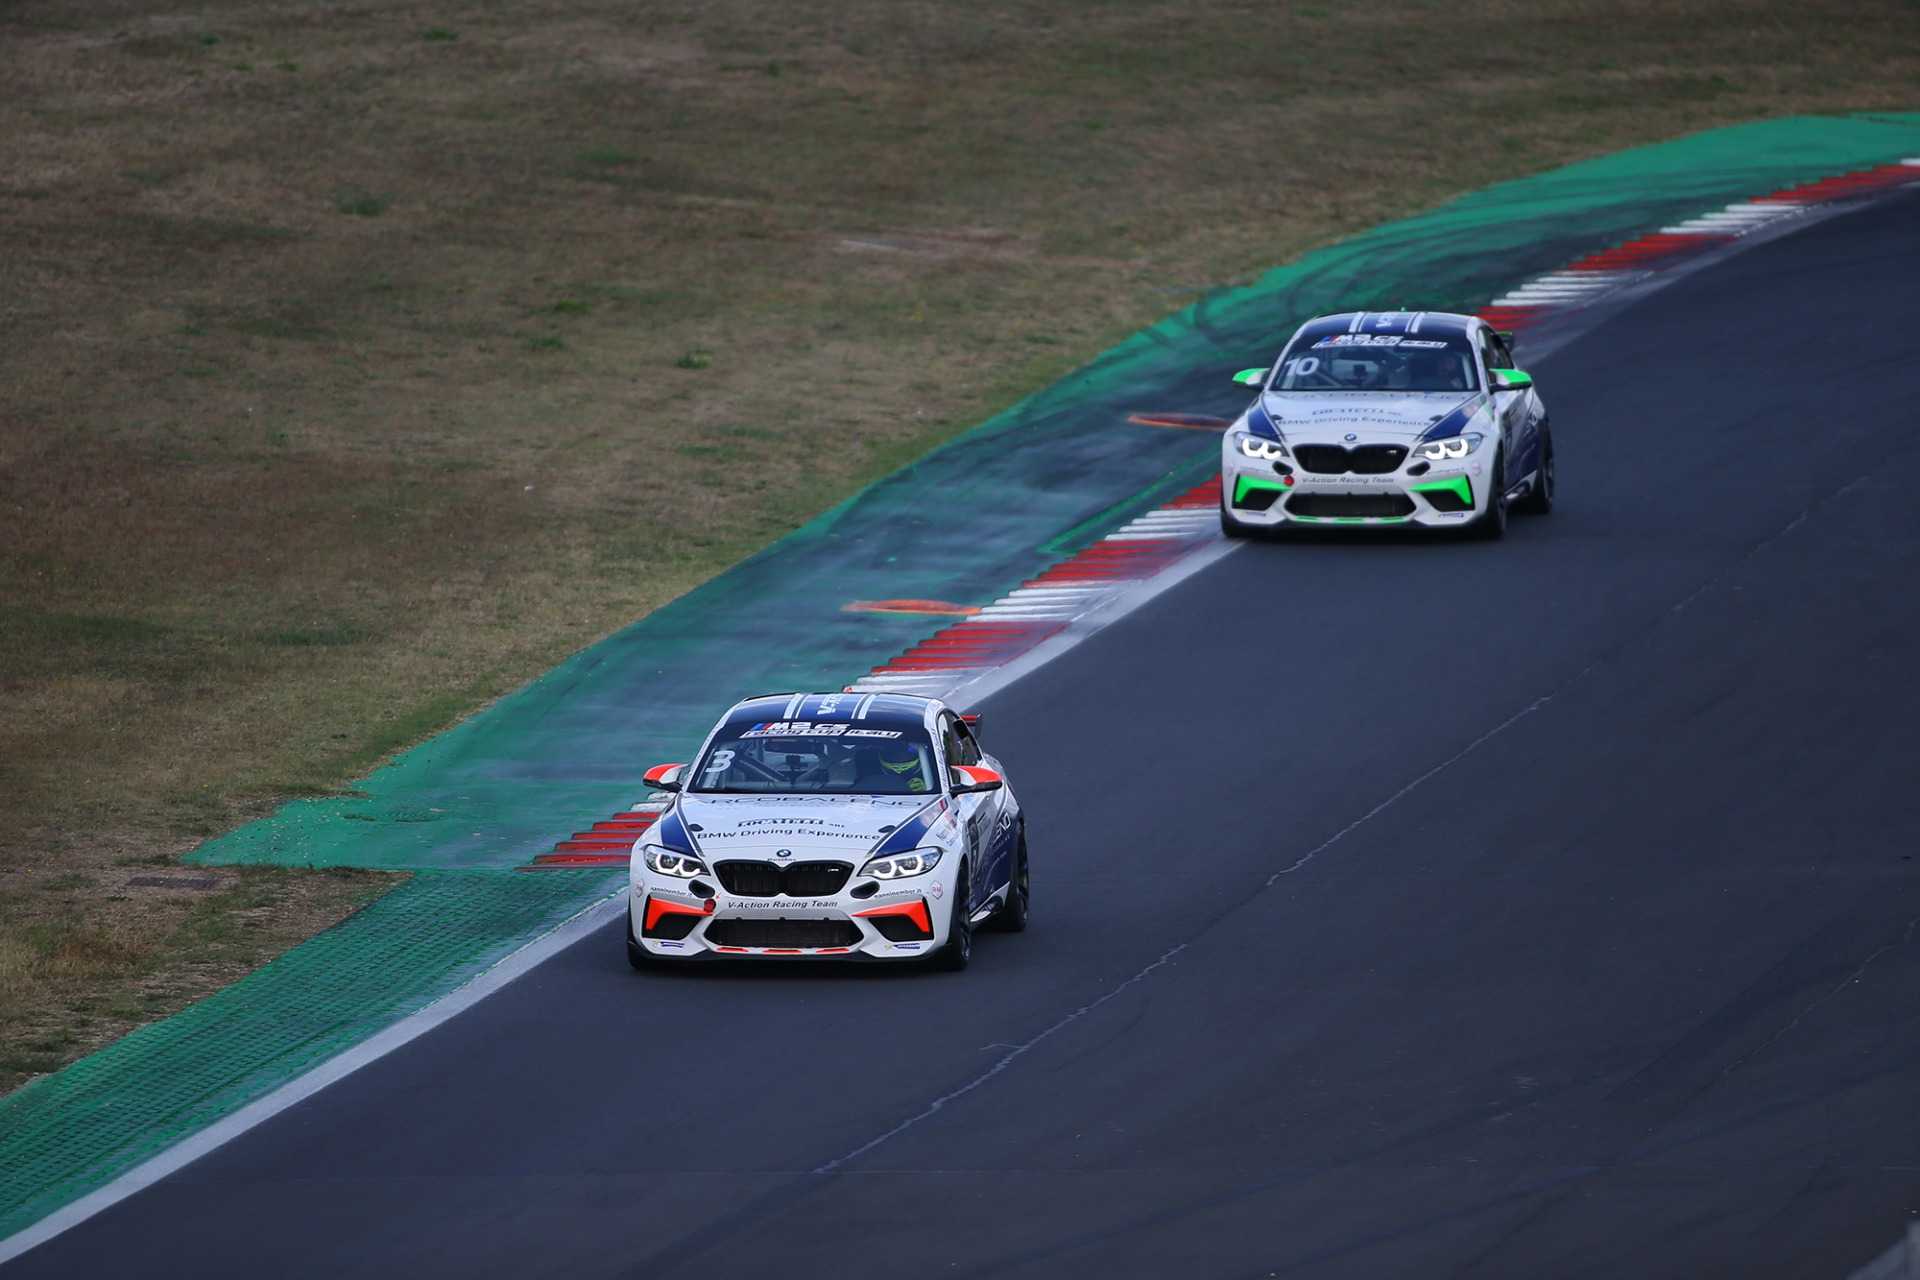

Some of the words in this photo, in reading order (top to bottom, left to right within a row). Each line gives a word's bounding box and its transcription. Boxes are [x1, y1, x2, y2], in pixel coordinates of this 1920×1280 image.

[1285, 357, 1320, 376] 10
[1340, 476, 1369, 485] Racing
[705, 750, 736, 773] 3
[697, 830, 737, 840] BMW
[740, 827, 793, 837] Driving
[797, 828, 881, 840] Experience
[728, 901, 770, 909] V-Action
[772, 900, 808, 909] Racing
[812, 900, 838, 908] Team
